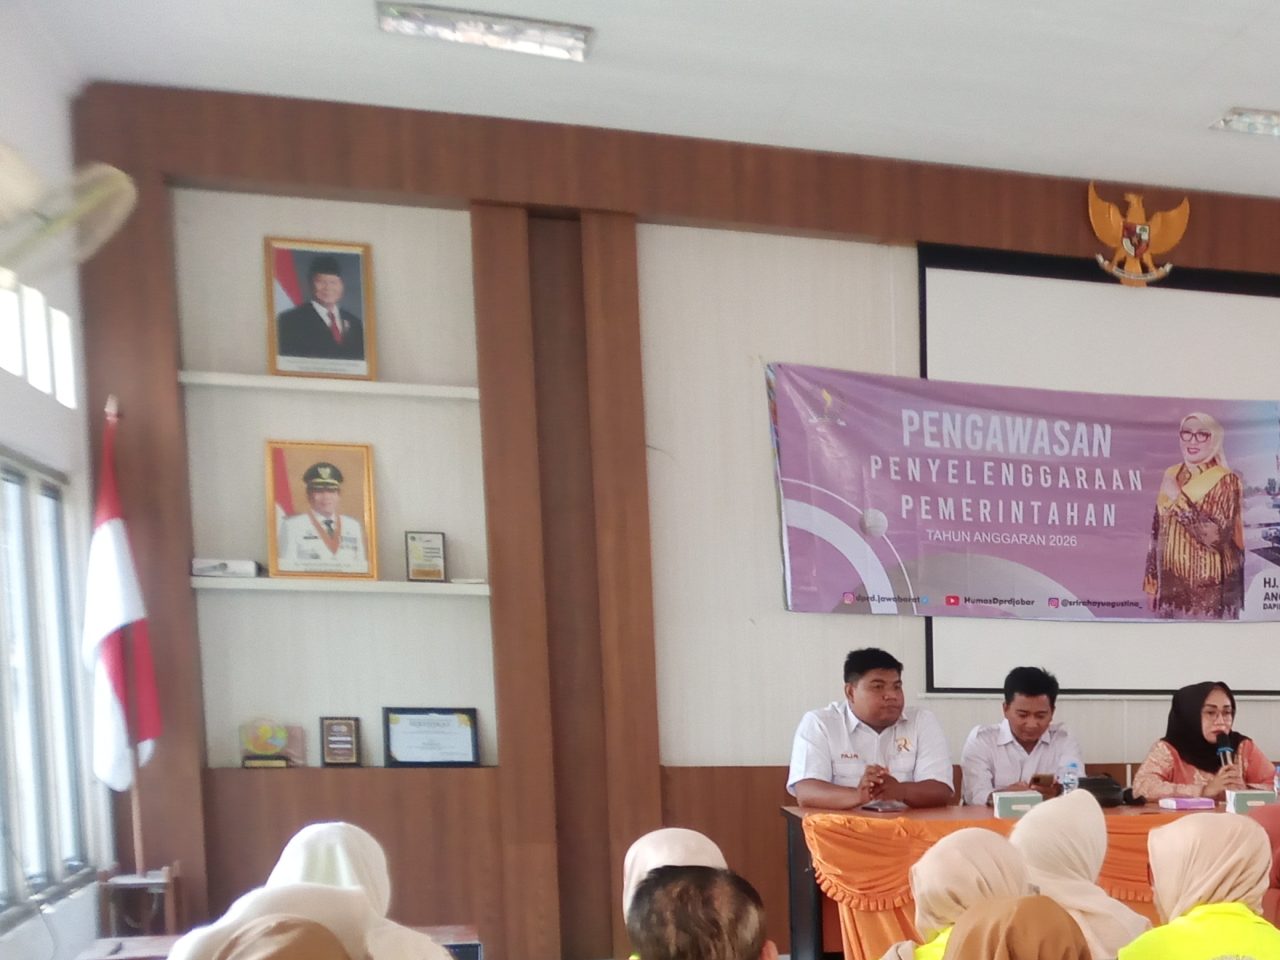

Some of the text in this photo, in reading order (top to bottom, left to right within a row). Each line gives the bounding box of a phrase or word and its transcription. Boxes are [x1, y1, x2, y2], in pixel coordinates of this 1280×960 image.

[901, 409, 1112, 458] PENGAWASAN
[870, 455, 1143, 491] PENYELENGGARAAN
[901, 494, 1116, 527] PEMERINTAHAN
[926, 529, 1078, 547] TAHUN ANGGARAN 2026
[1263, 577, 1279, 589] HJ.
